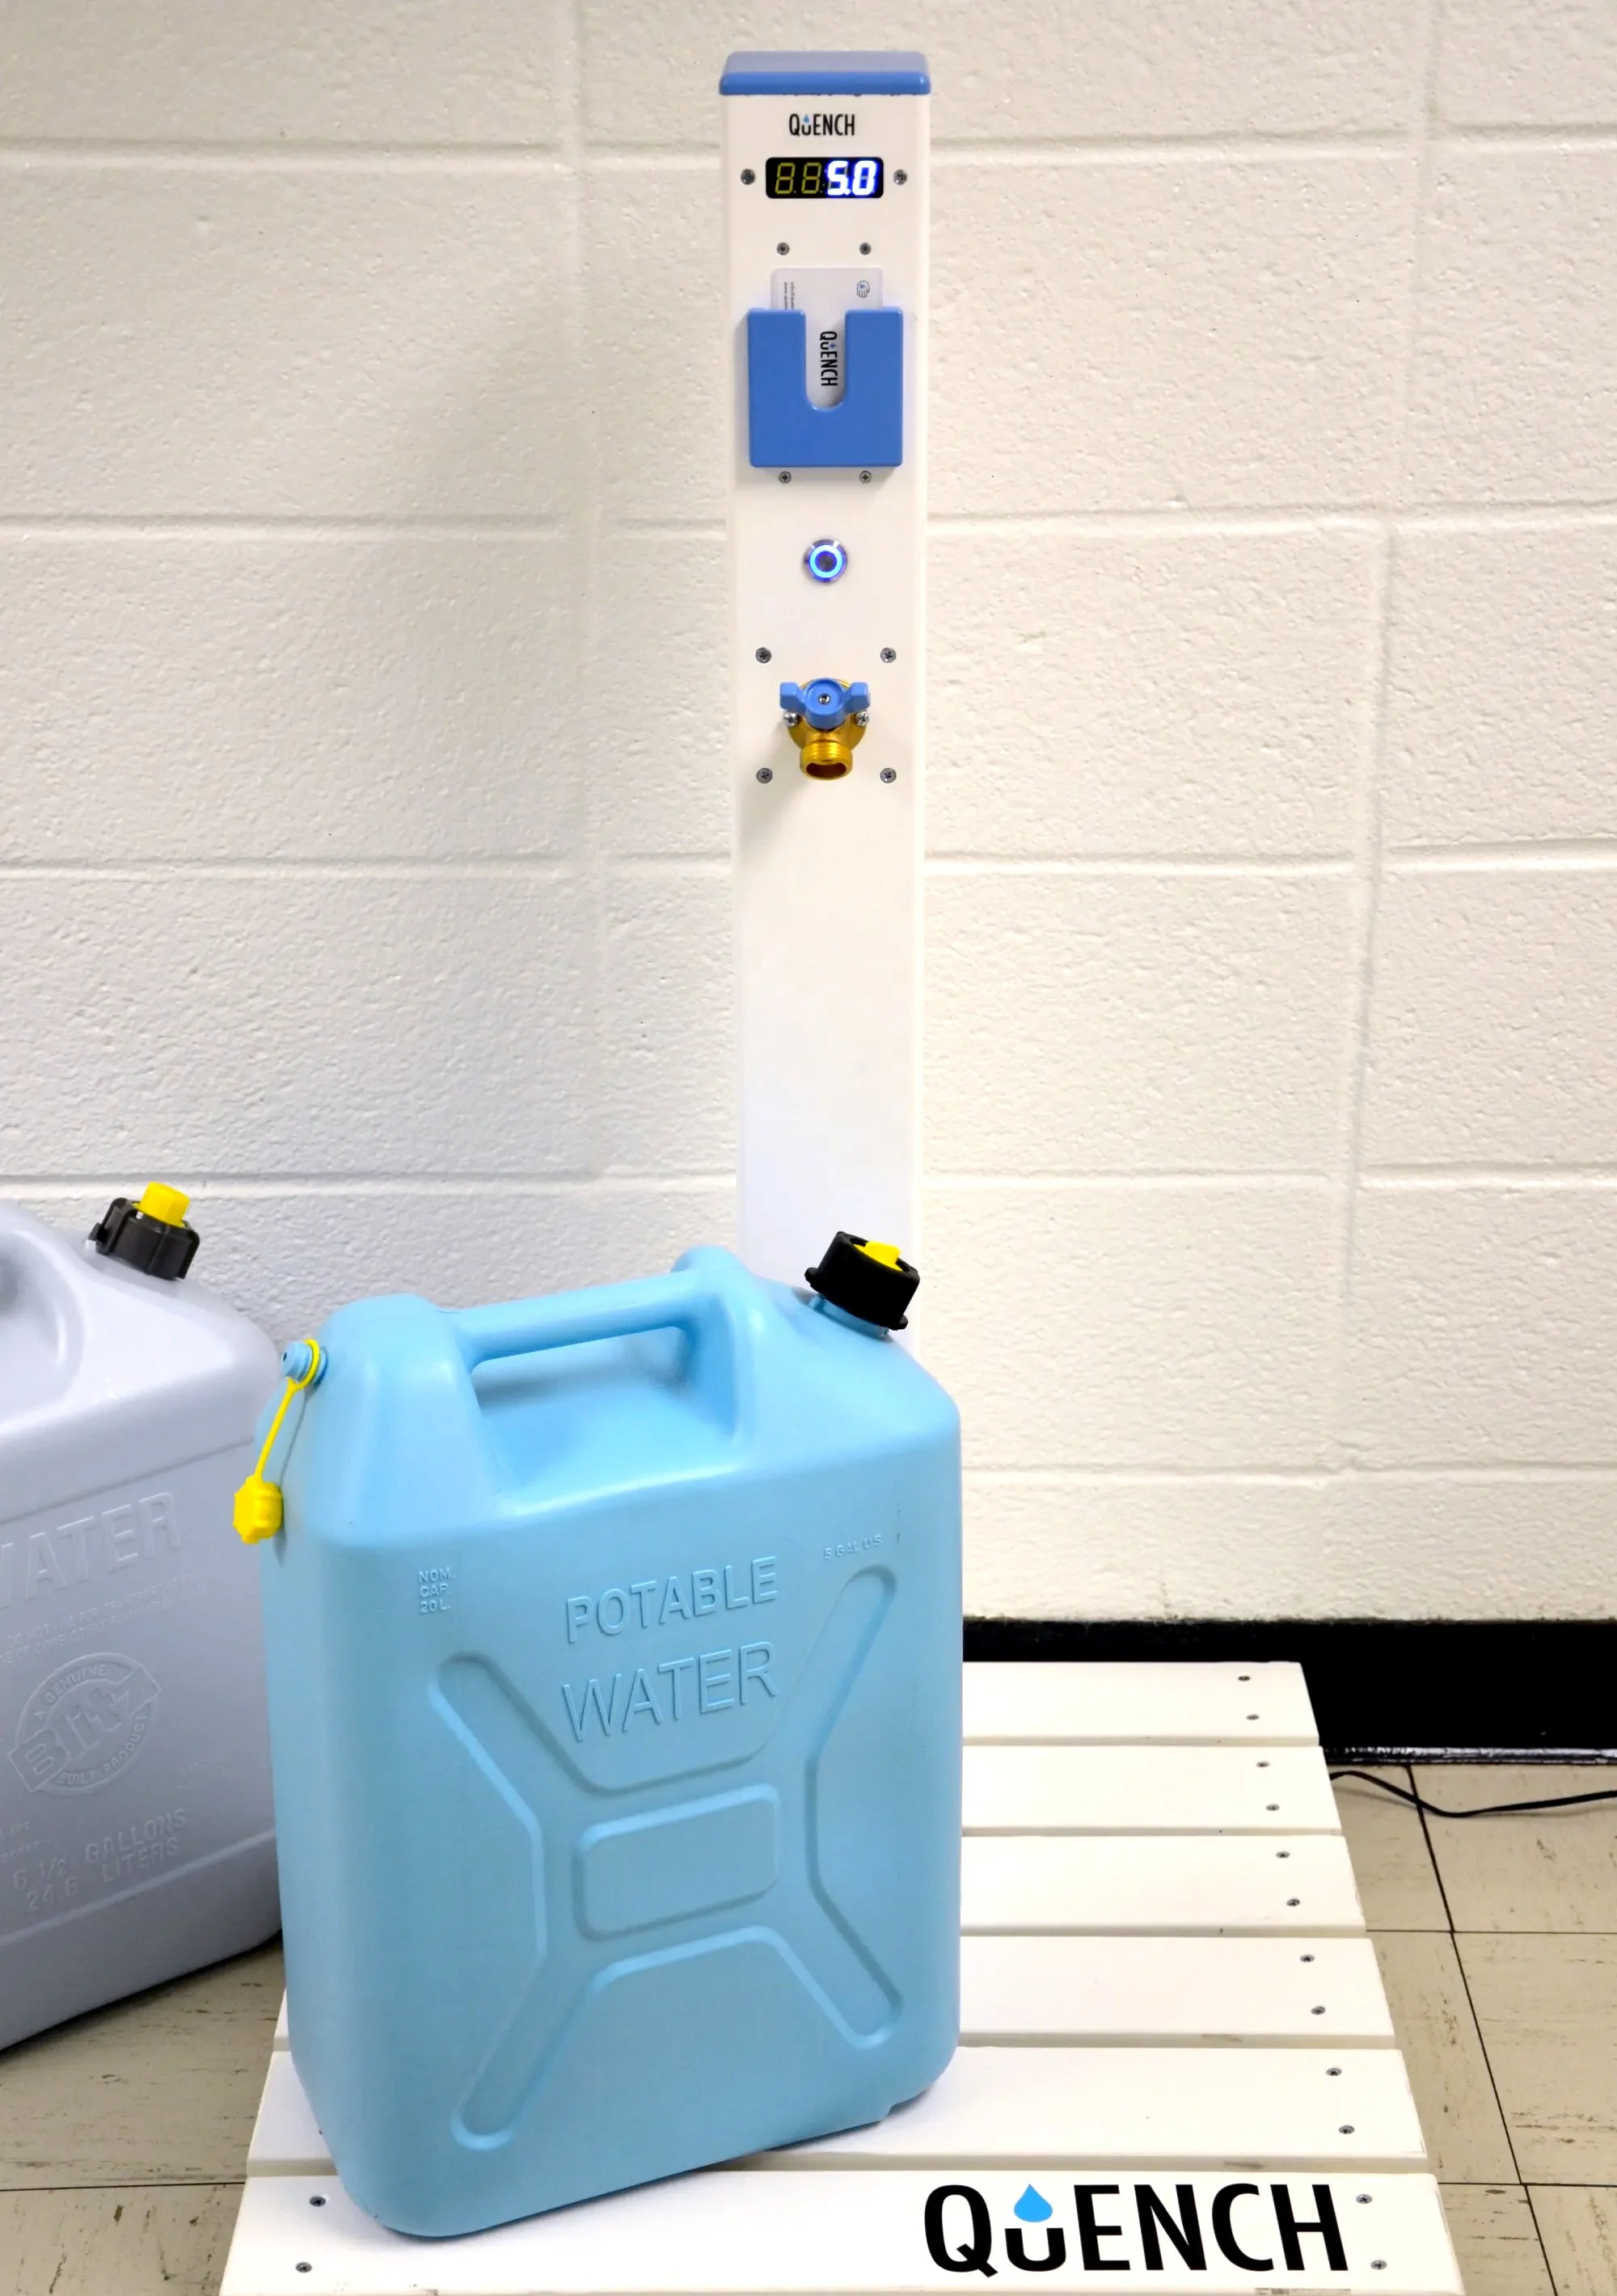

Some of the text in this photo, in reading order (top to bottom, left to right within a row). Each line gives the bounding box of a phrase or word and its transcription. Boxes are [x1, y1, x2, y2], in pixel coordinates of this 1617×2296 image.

[788, 112, 855, 137] QUENCH
[819, 330, 838, 386] QUENCH
[0, 1491, 184, 1610] ATER
[418, 1566, 457, 1584] NOM.
[419, 1582, 450, 1598] CAP.
[419, 1599, 437, 1614] 20
[565, 1555, 780, 1645] POTABLE
[44, 1664, 108, 1704] GENUINE
[562, 1640, 781, 1743] WATER
[57, 1714, 148, 1786] BUILT PRODUCT
[12, 1868, 27, 1891] 6
[85, 1807, 187, 1864] GALLONS
[27, 1875, 79, 1912] 24.6
[101, 1835, 179, 1884] LITERS
[923, 2182, 1349, 2278] QUENCH
